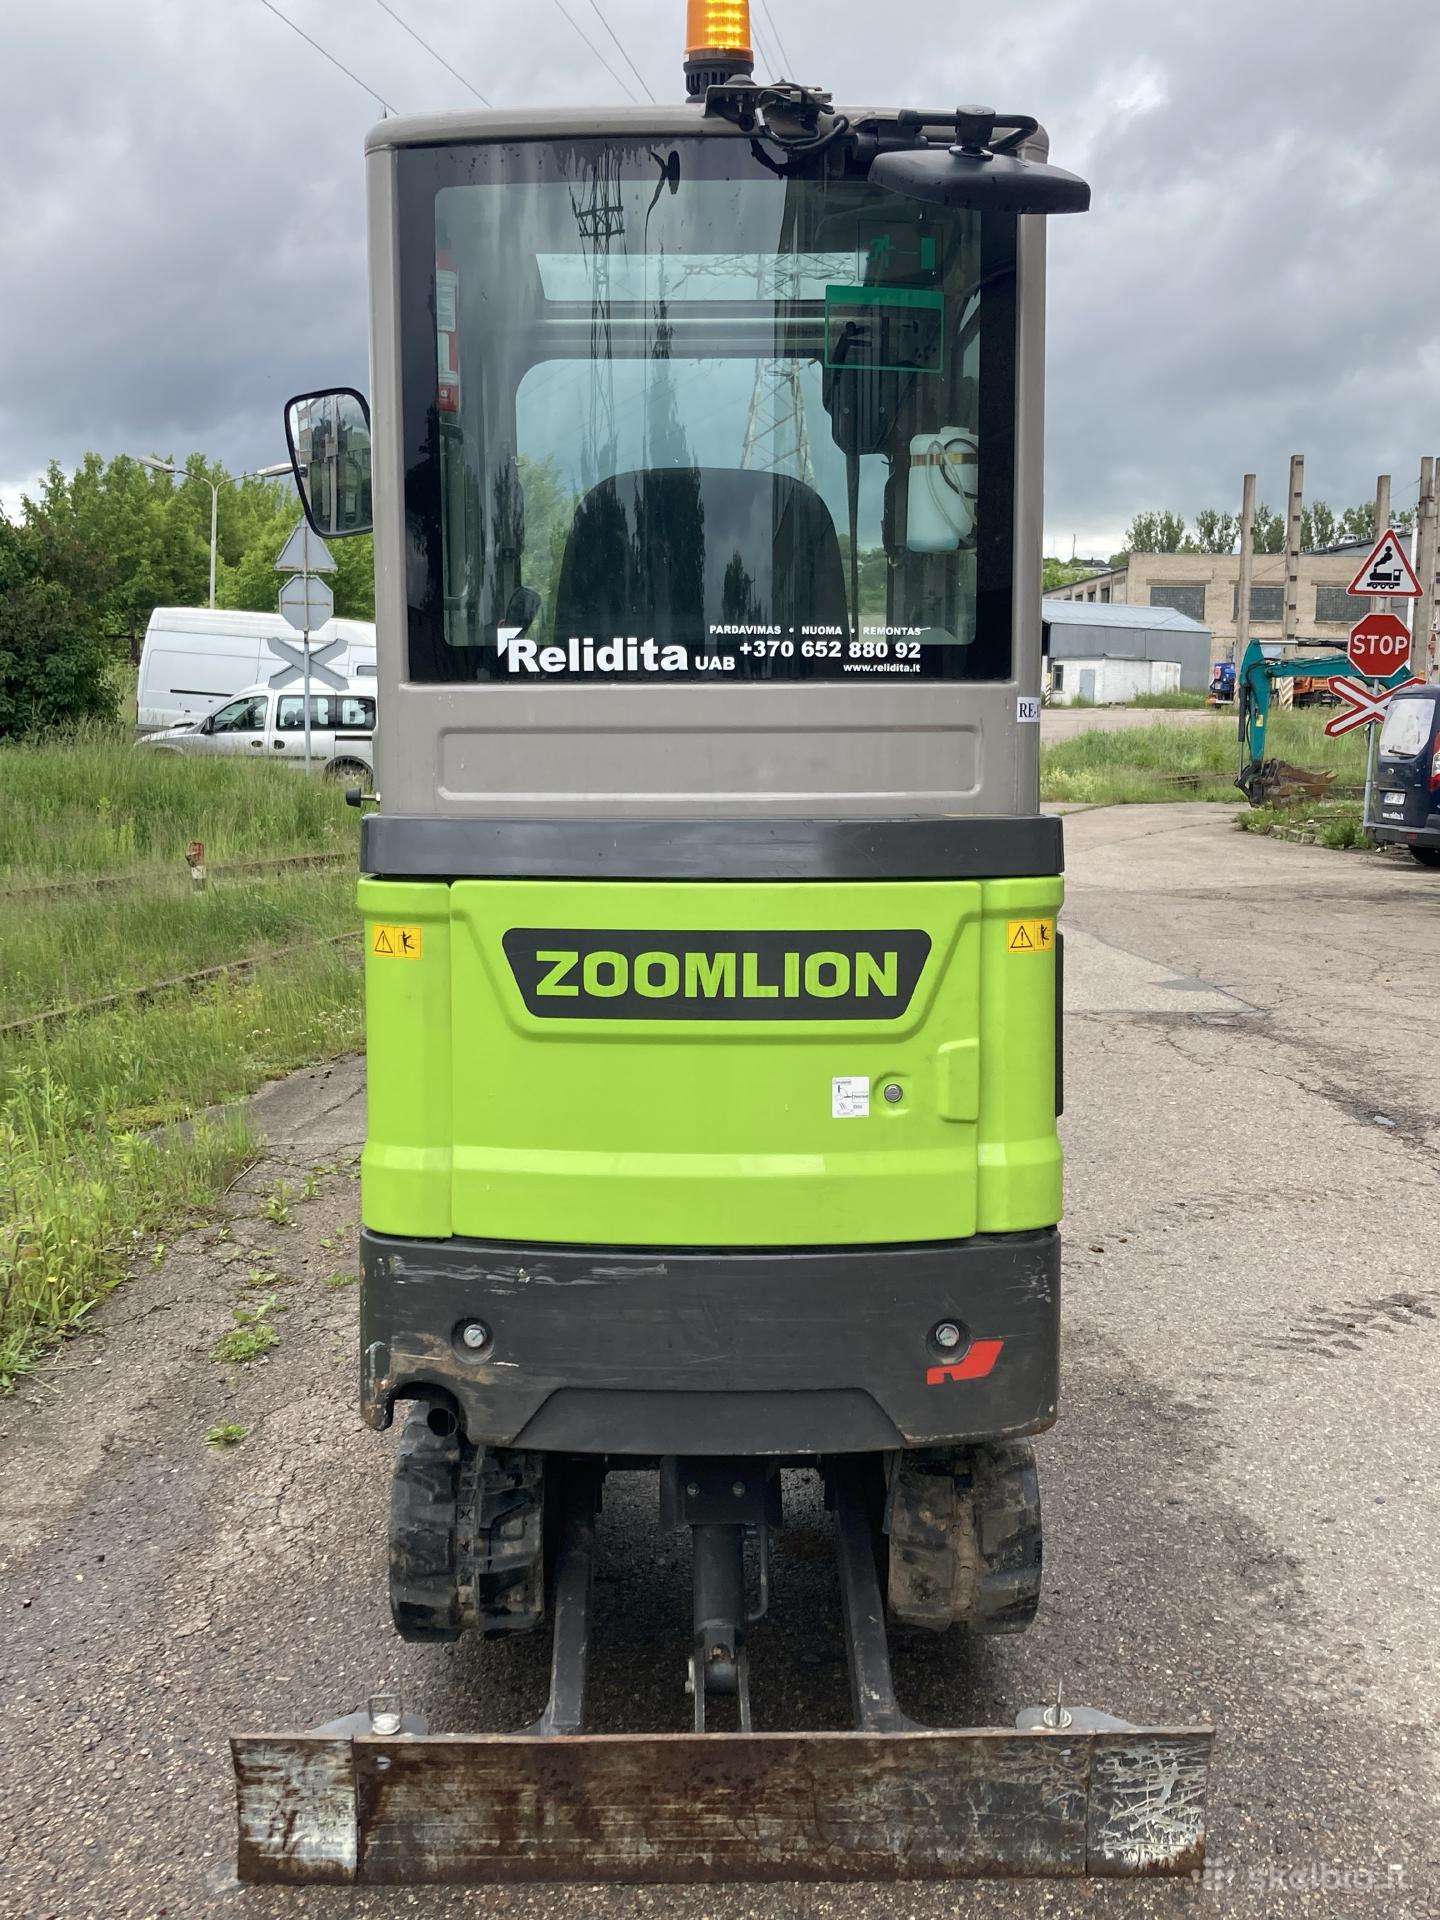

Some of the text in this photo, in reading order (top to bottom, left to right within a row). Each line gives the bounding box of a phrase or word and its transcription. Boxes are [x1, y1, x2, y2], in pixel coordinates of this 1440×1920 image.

[709, 625, 922, 636] PARDAVIMAS NUOMA REMONTAS
[498, 627, 736, 672] Relidita UAB
[739, 641, 921, 659] +370 652 880 92
[1352, 634, 1408, 655] STOP
[843, 663, 921, 673] www.relidita.lt
[535, 950, 898, 998] ZOOMLION
